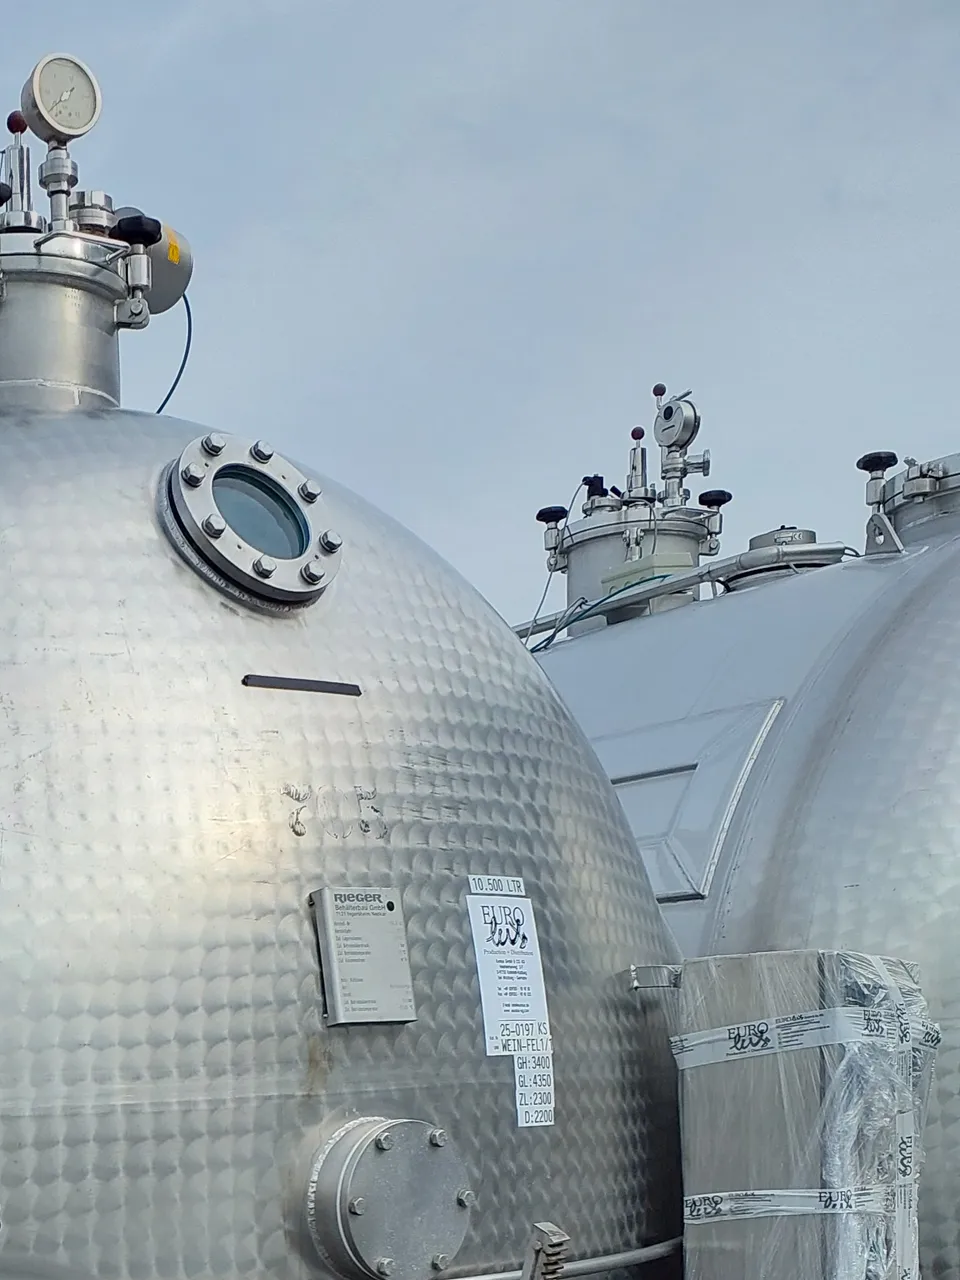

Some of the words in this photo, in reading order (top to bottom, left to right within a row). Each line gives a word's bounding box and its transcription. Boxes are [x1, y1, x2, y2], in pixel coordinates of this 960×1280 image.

[472, 877, 504, 892] 10.500
[507, 879, 523, 893] LTR
[481, 905, 525, 927] EURO
[500, 1023, 534, 1037] 25-0197
[537, 1021, 548, 1036] KS
[727, 1022, 769, 1040] EURO
[516, 1055, 551, 1070] GH:3400
[518, 1074, 552, 1088] GL:4350
[519, 1092, 552, 1106] ZL:2300
[524, 1110, 553, 1124] D:2200
[685, 1195, 723, 1208] EURO
